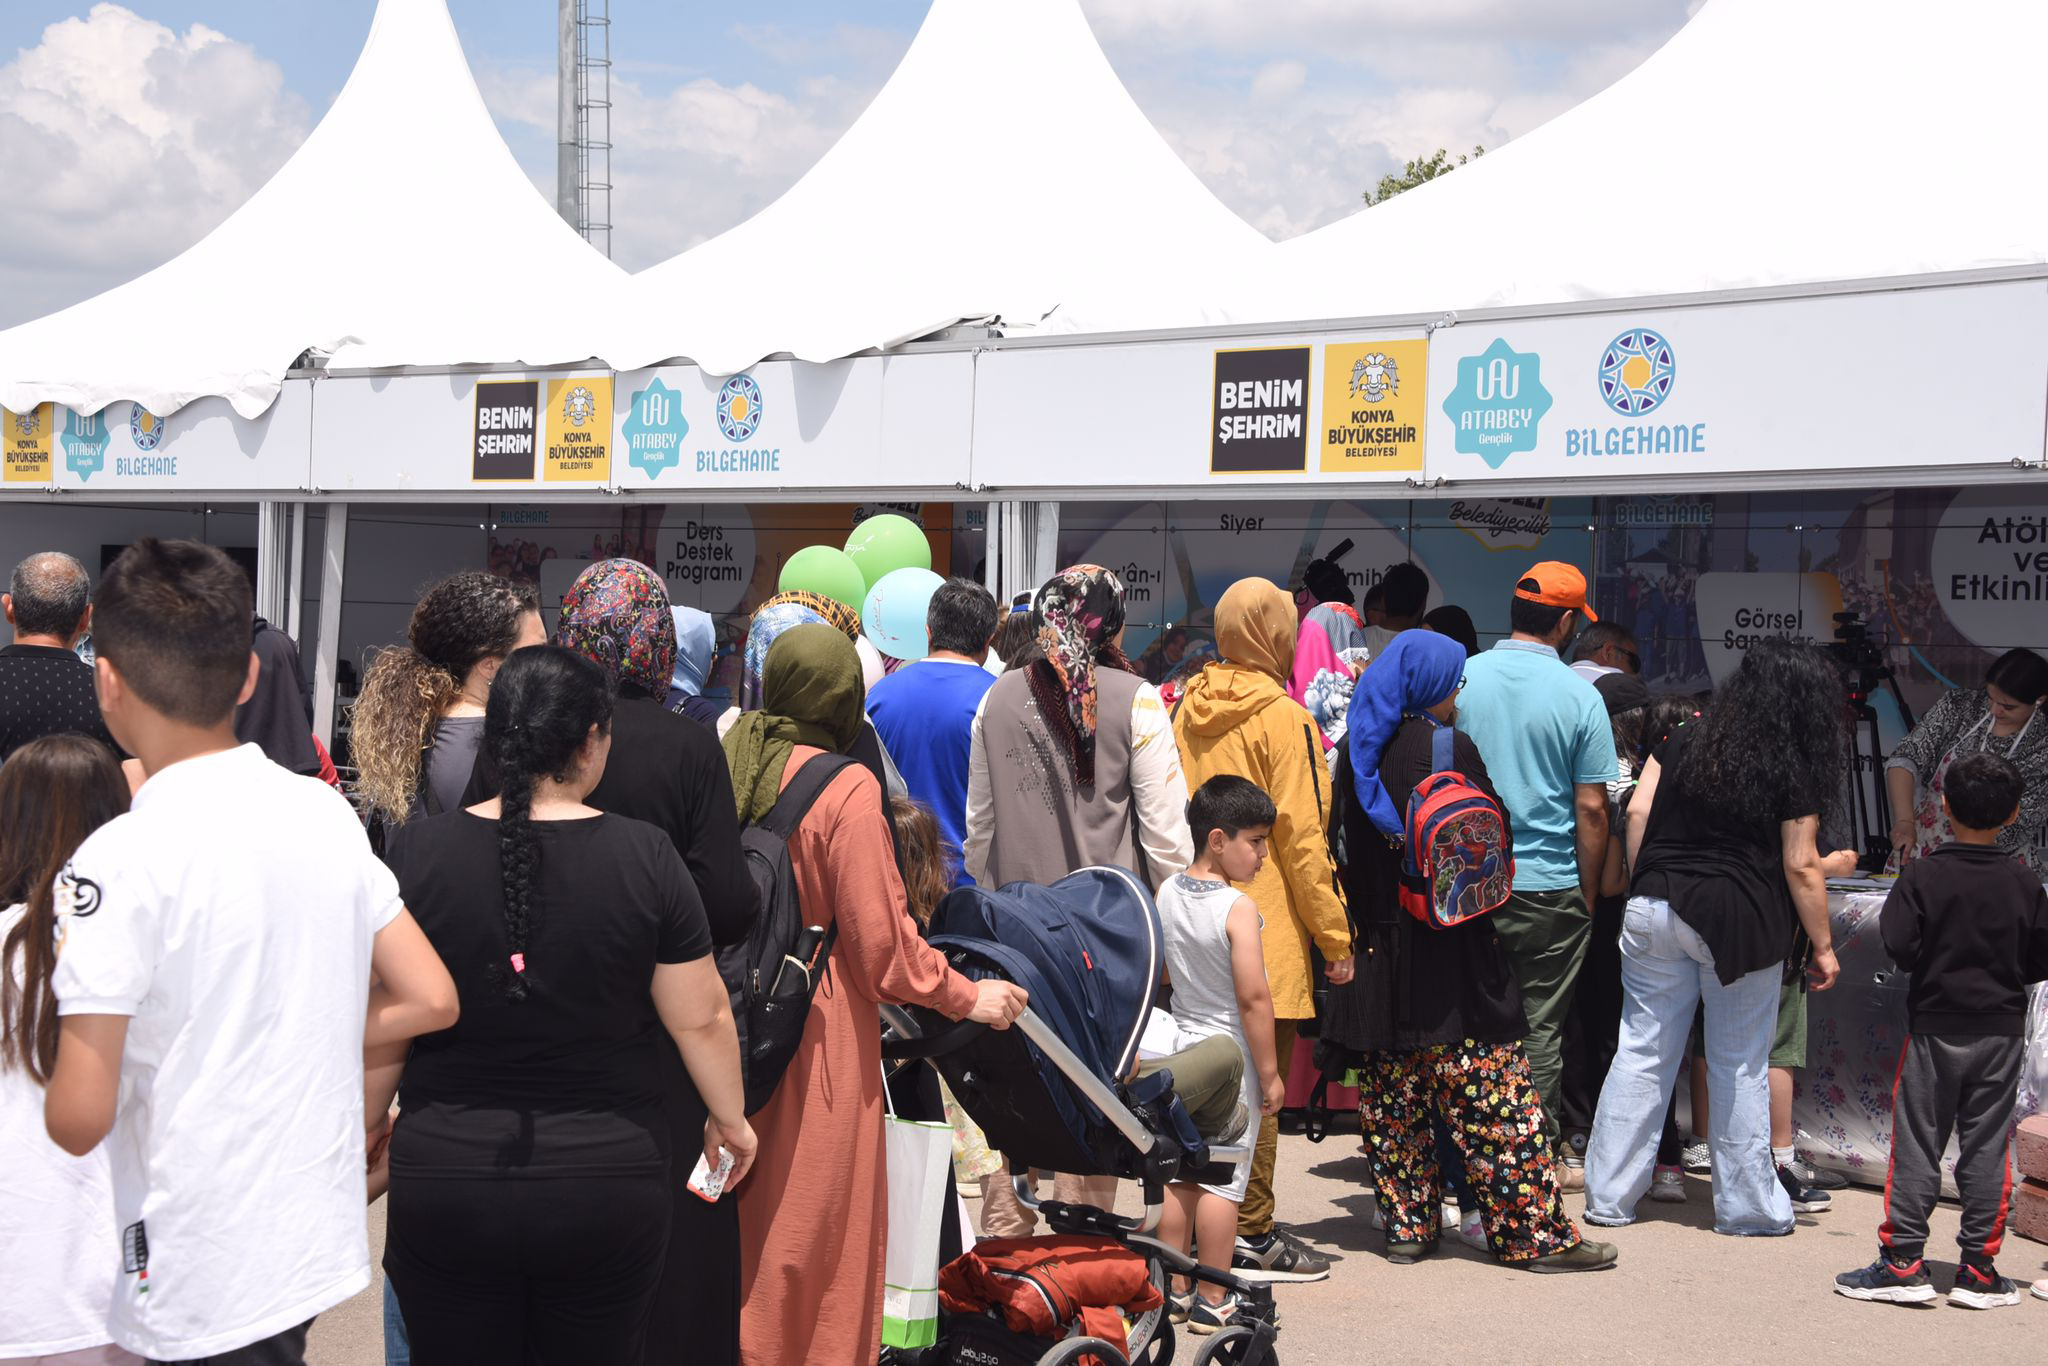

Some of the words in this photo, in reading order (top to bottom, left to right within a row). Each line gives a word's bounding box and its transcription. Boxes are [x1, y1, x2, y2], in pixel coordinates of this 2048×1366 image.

[1350, 410, 1396, 425] KONYA
[1459, 407, 1533, 431] ATABEY
[16, 440, 39, 450] KONYA
[563, 432, 592, 443] KONYA
[632, 431, 677, 449] ATABEY
[1327, 424, 1417, 448] BÜYÜKŞEHİR
[1477, 431, 1514, 446] Gençlik
[6, 450, 49, 465] BÜYÜKŞEHİR
[68, 443, 102, 456] ATABEY
[549, 444, 606, 462] BÜYÜKŞEHİR
[1344, 444, 1398, 458] BELEDİYESİ
[559, 460, 594, 470] BELEDİYESİ
[1220, 513, 1265, 535] Siyer
[1449, 501, 1551, 537] Belediyecilik
[686, 521, 723, 542] Ders
[676, 541, 734, 561] Destek
[2013, 552, 2048, 573] ve
[666, 561, 743, 585] Programı
[1735, 607, 1803, 630] Görsel
